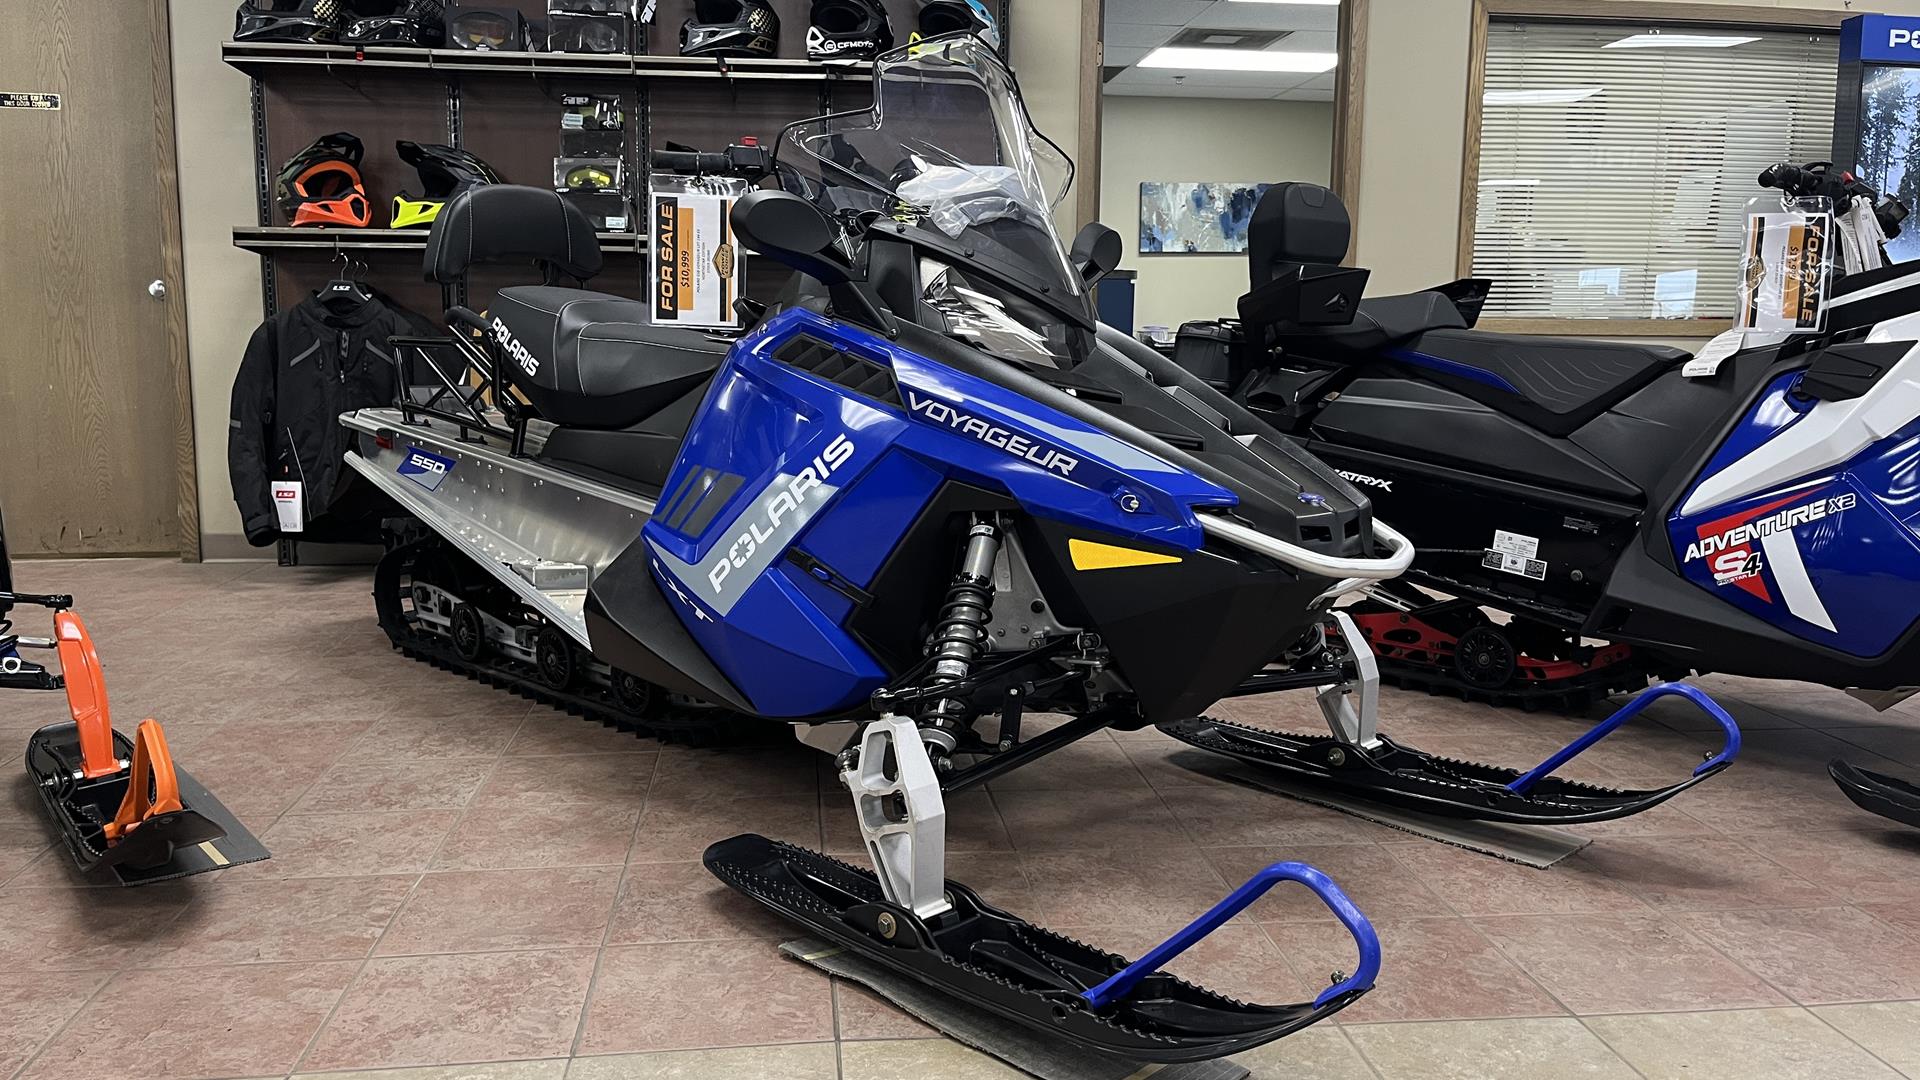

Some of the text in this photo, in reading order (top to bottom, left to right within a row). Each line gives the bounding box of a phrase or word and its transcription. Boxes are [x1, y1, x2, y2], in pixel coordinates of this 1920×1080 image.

[838, 40, 874, 49] CFMOTO
[662, 204, 674, 311] FOR SALE
[681, 250, 691, 288] $10,999
[1802, 225, 1820, 322] FOR SALE
[492, 316, 540, 376] POLARIS
[908, 391, 1078, 476] VOYAGEUR
[1334, 468, 1392, 492] ATRYX
[708, 434, 854, 594] POLARIS
[1684, 493, 1856, 563] ADVENTURE X2
[652, 558, 714, 622] LXT
[1714, 550, 1762, 581] S4
